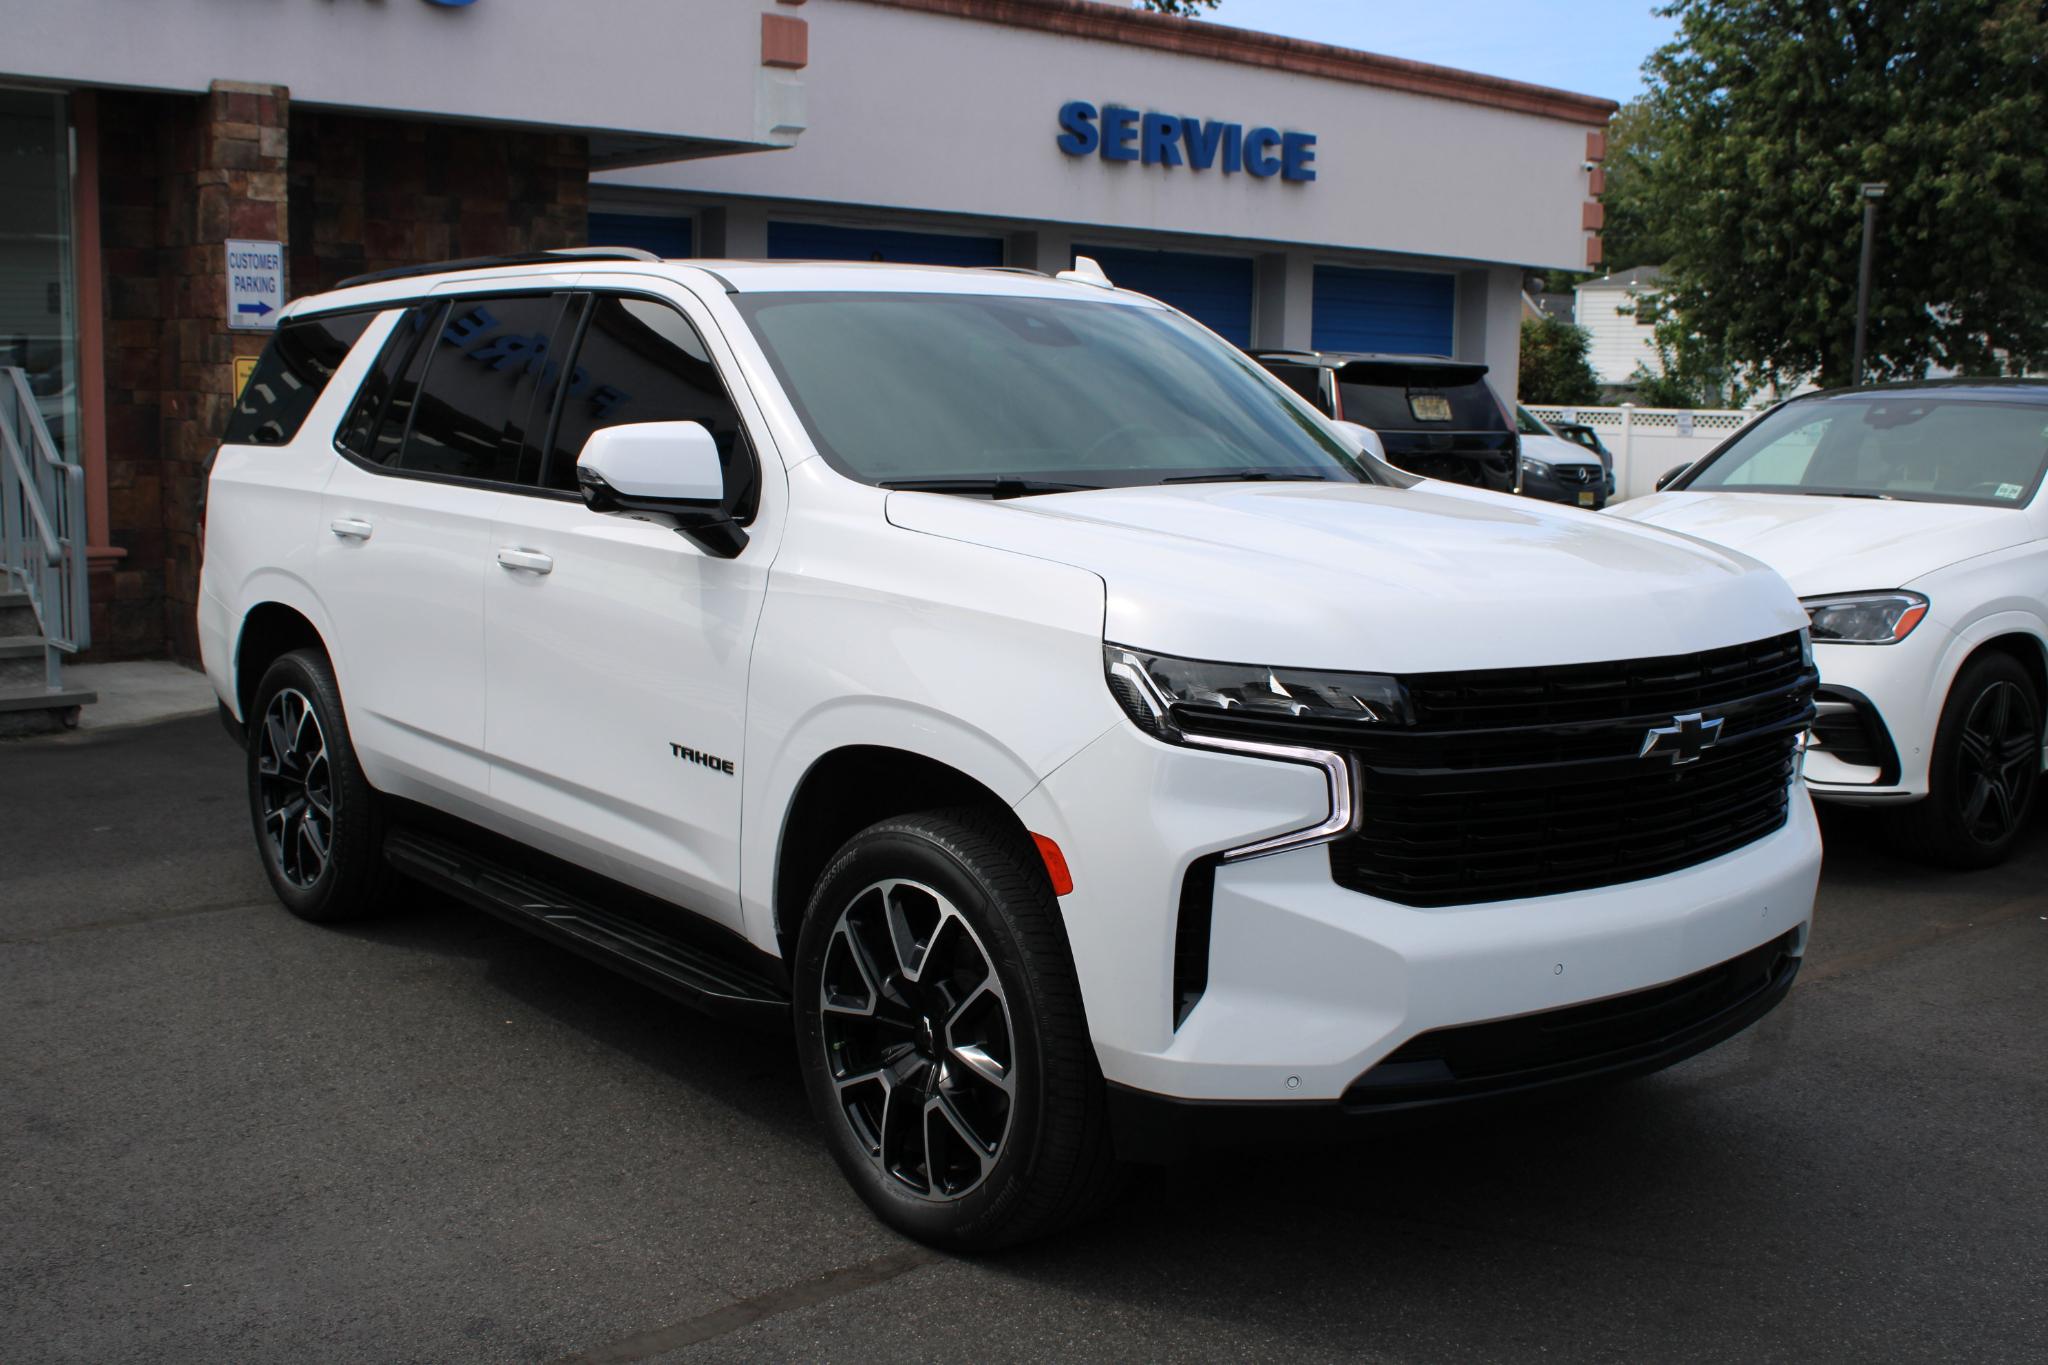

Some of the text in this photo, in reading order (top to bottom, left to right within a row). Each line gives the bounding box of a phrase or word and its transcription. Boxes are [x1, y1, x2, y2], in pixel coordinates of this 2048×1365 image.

[1057, 101, 1317, 181] SERVICE
[229, 252, 278, 270] CUSTOMER
[234, 275, 276, 293] PARKING
[669, 741, 734, 776] TAHOE
[807, 847, 858, 920] BRIDGESTONE
